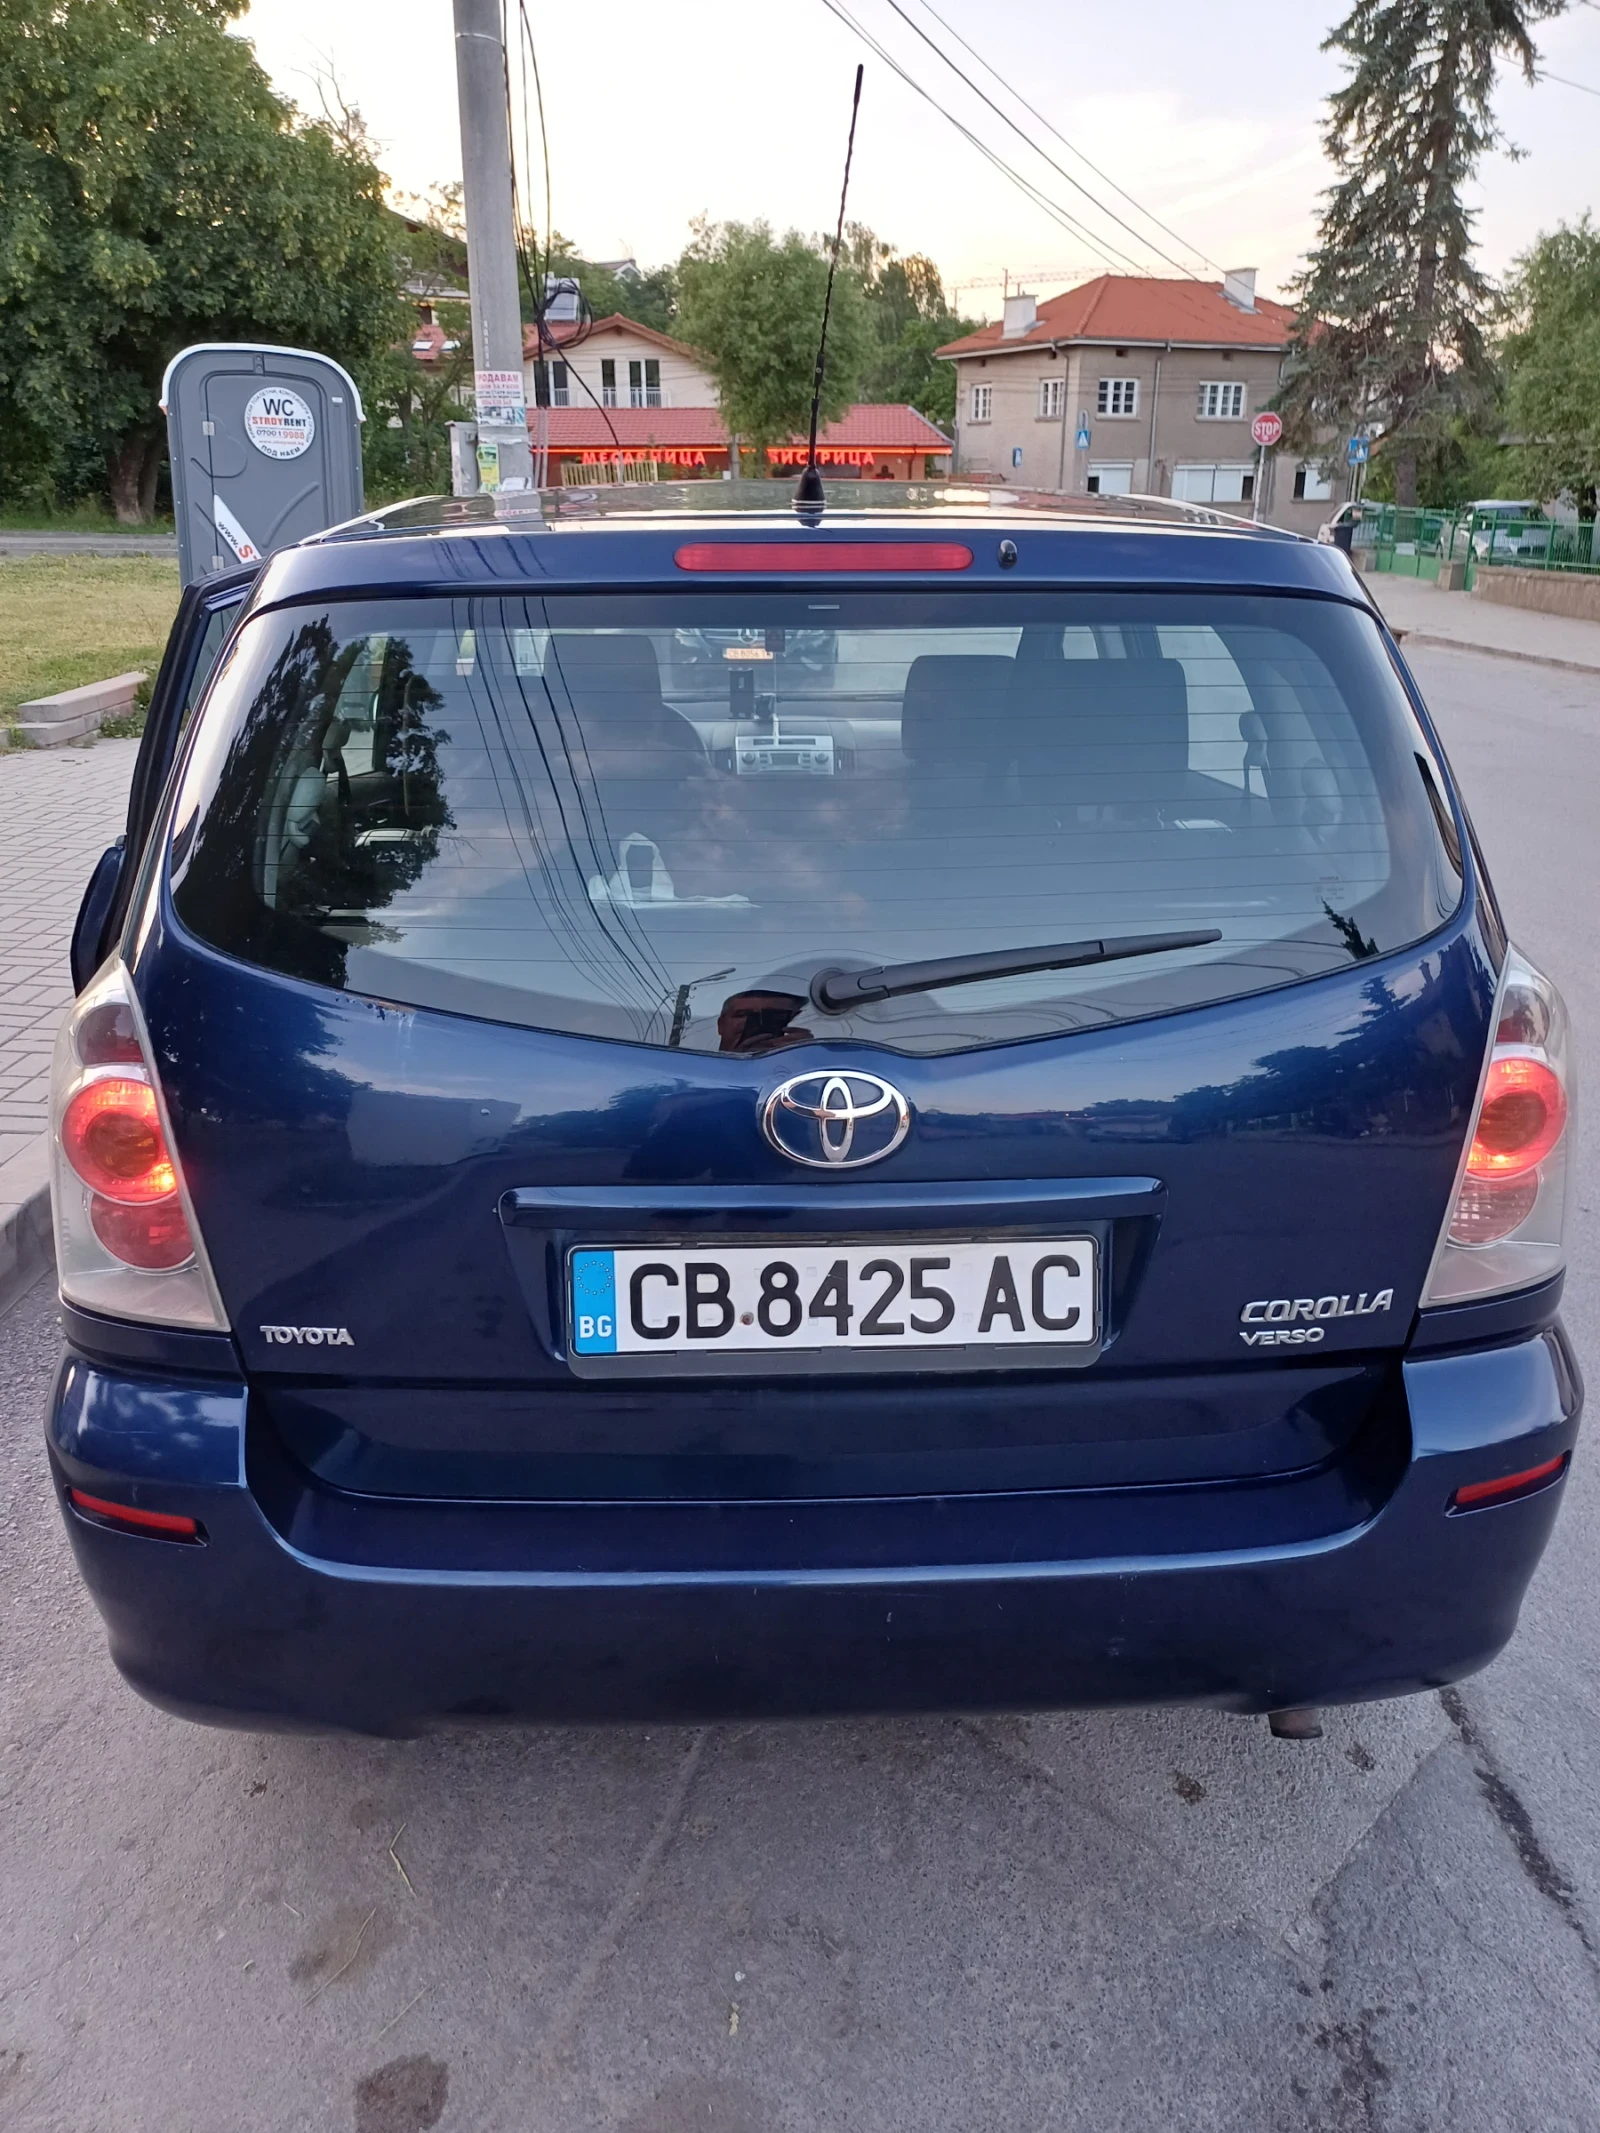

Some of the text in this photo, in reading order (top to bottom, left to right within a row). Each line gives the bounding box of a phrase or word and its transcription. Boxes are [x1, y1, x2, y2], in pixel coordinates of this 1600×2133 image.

[262, 397, 294, 416] WC
[252, 416, 306, 427] STROYRENT
[1254, 421, 1280, 436] STOP
[261, 445, 301, 457] ПОД НАЕМ
[582, 450, 706, 467] МЕСАРНИЦА
[629, 1253, 1081, 1340] CB 8425 AC
[1240, 1288, 1394, 1323] COROLLA
[259, 1325, 355, 1346] TOYOTA
[579, 1315, 612, 1339] BG
[1239, 1327, 1325, 1346] VERSO
